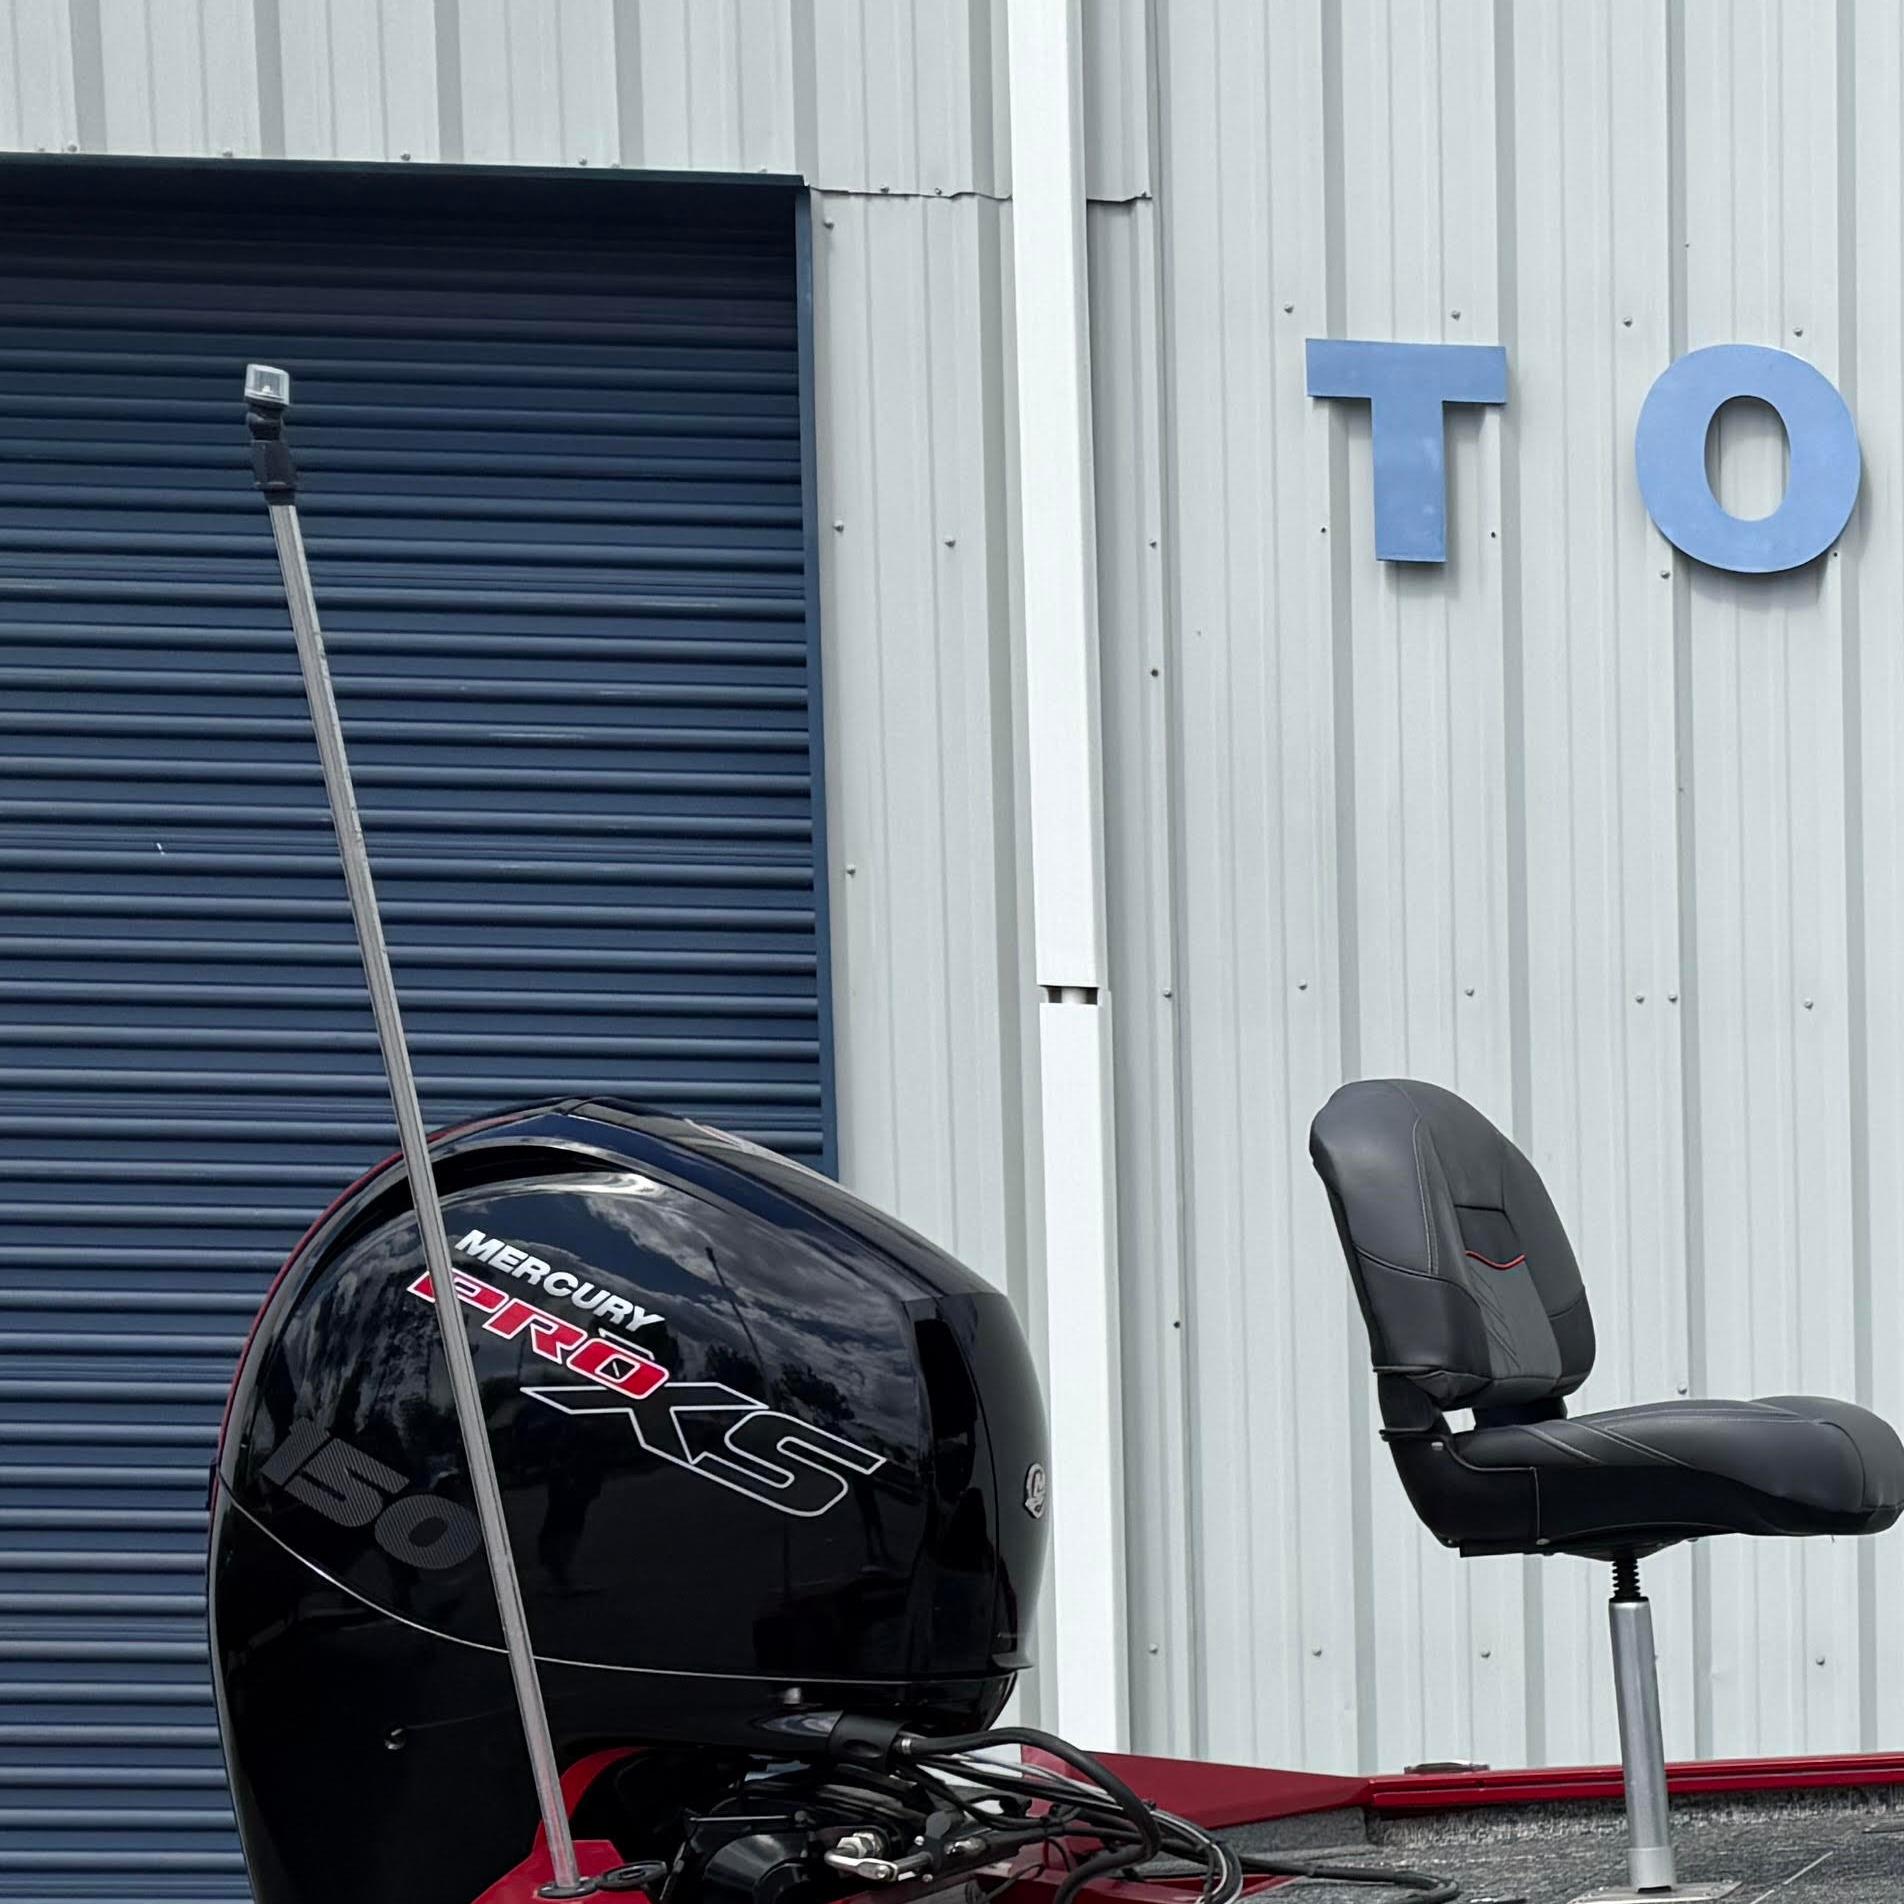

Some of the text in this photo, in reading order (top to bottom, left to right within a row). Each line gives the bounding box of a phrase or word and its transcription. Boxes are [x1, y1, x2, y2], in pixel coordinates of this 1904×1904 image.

[454, 1228, 666, 1332] MERCURY
[406, 1266, 887, 1518] PRO XS
[258, 1416, 482, 1570] 150
